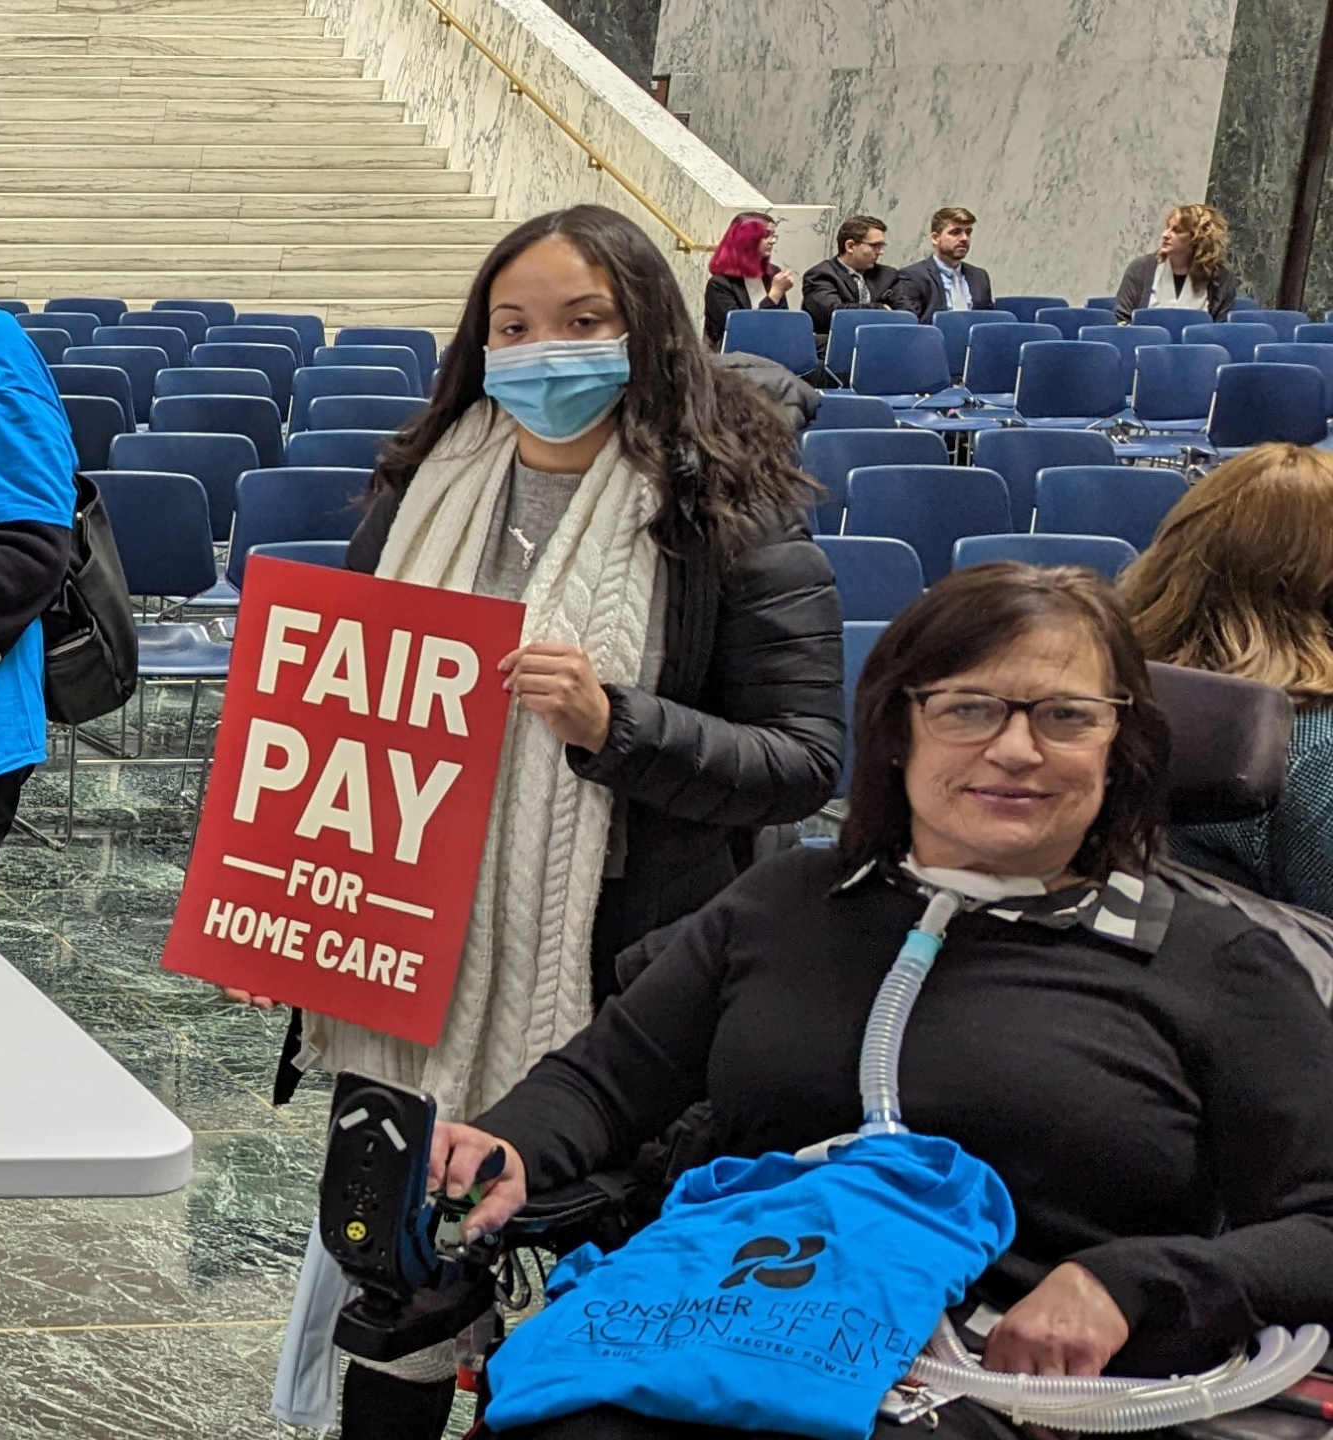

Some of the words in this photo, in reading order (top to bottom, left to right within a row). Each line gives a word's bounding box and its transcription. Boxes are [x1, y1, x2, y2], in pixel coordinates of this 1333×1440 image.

[257, 604, 480, 737] FAIR
[233, 717, 463, 865] PAY
[286, 859, 363, 914] FOR
[203, 898, 310, 960] HOME
[315, 930, 424, 993] CARE
[567, 1314, 733, 1343] ACTION
[750, 1316, 813, 1337] OF
[584, 1295, 752, 1320] CONSUMER
[802, 1351, 859, 1380] POWER
